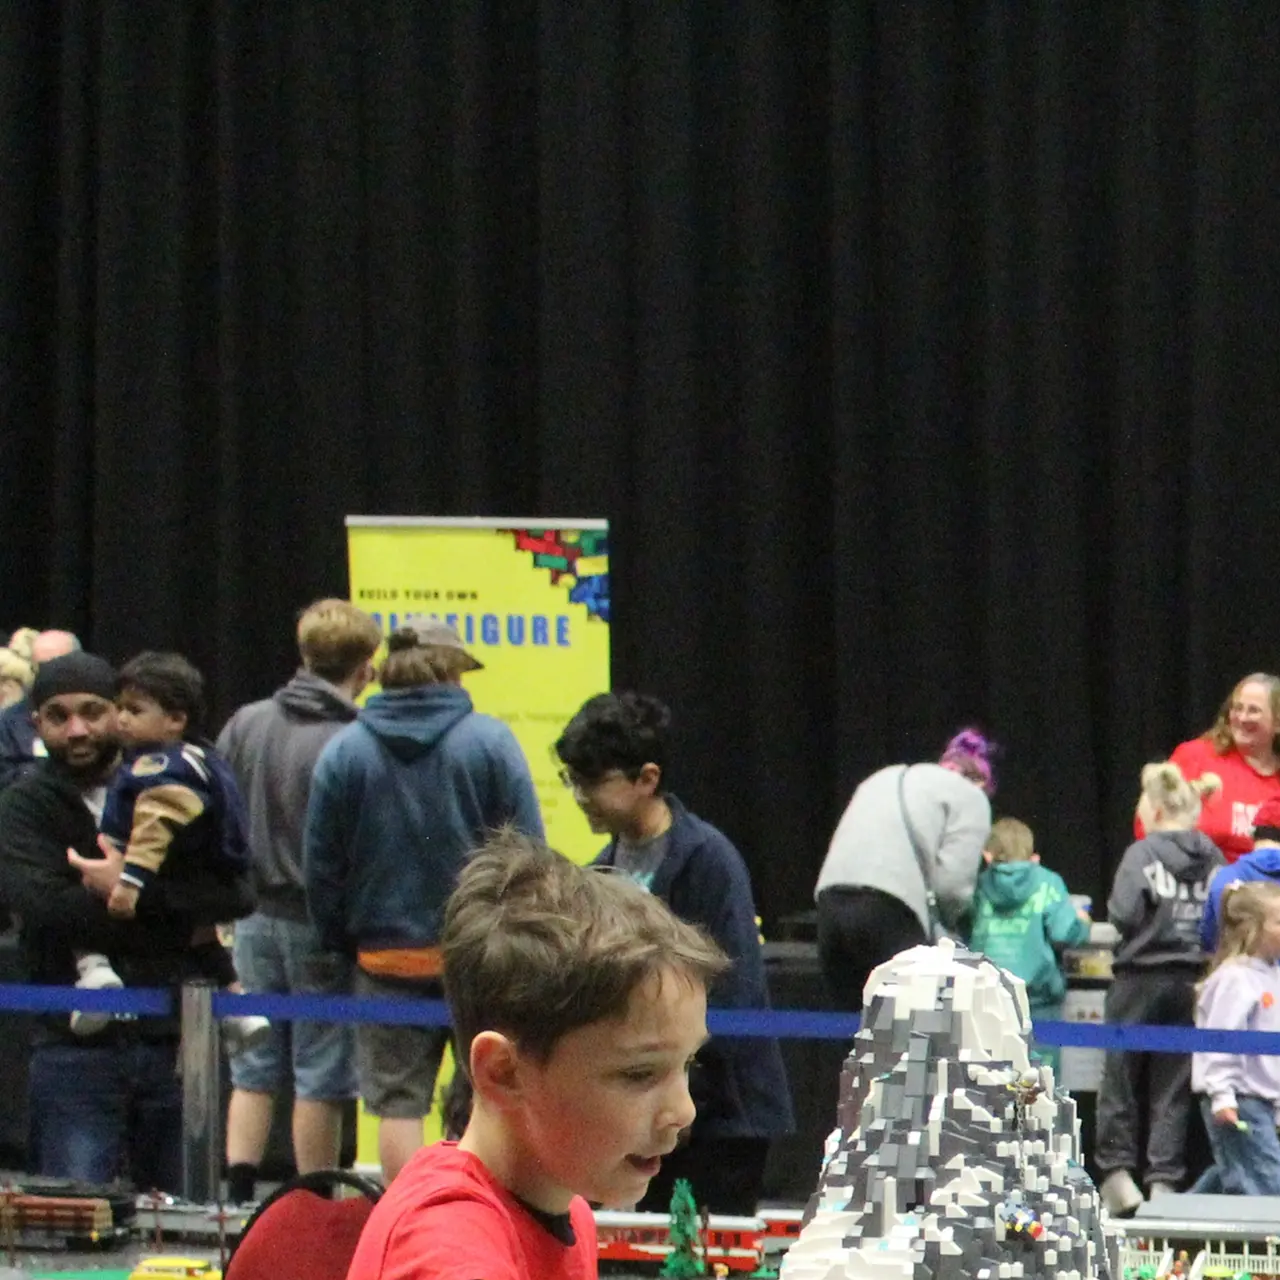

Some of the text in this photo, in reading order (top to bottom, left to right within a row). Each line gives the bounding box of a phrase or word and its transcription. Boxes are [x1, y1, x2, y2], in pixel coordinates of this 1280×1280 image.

[358, 589, 479, 601] BUILD YOUR OWN
